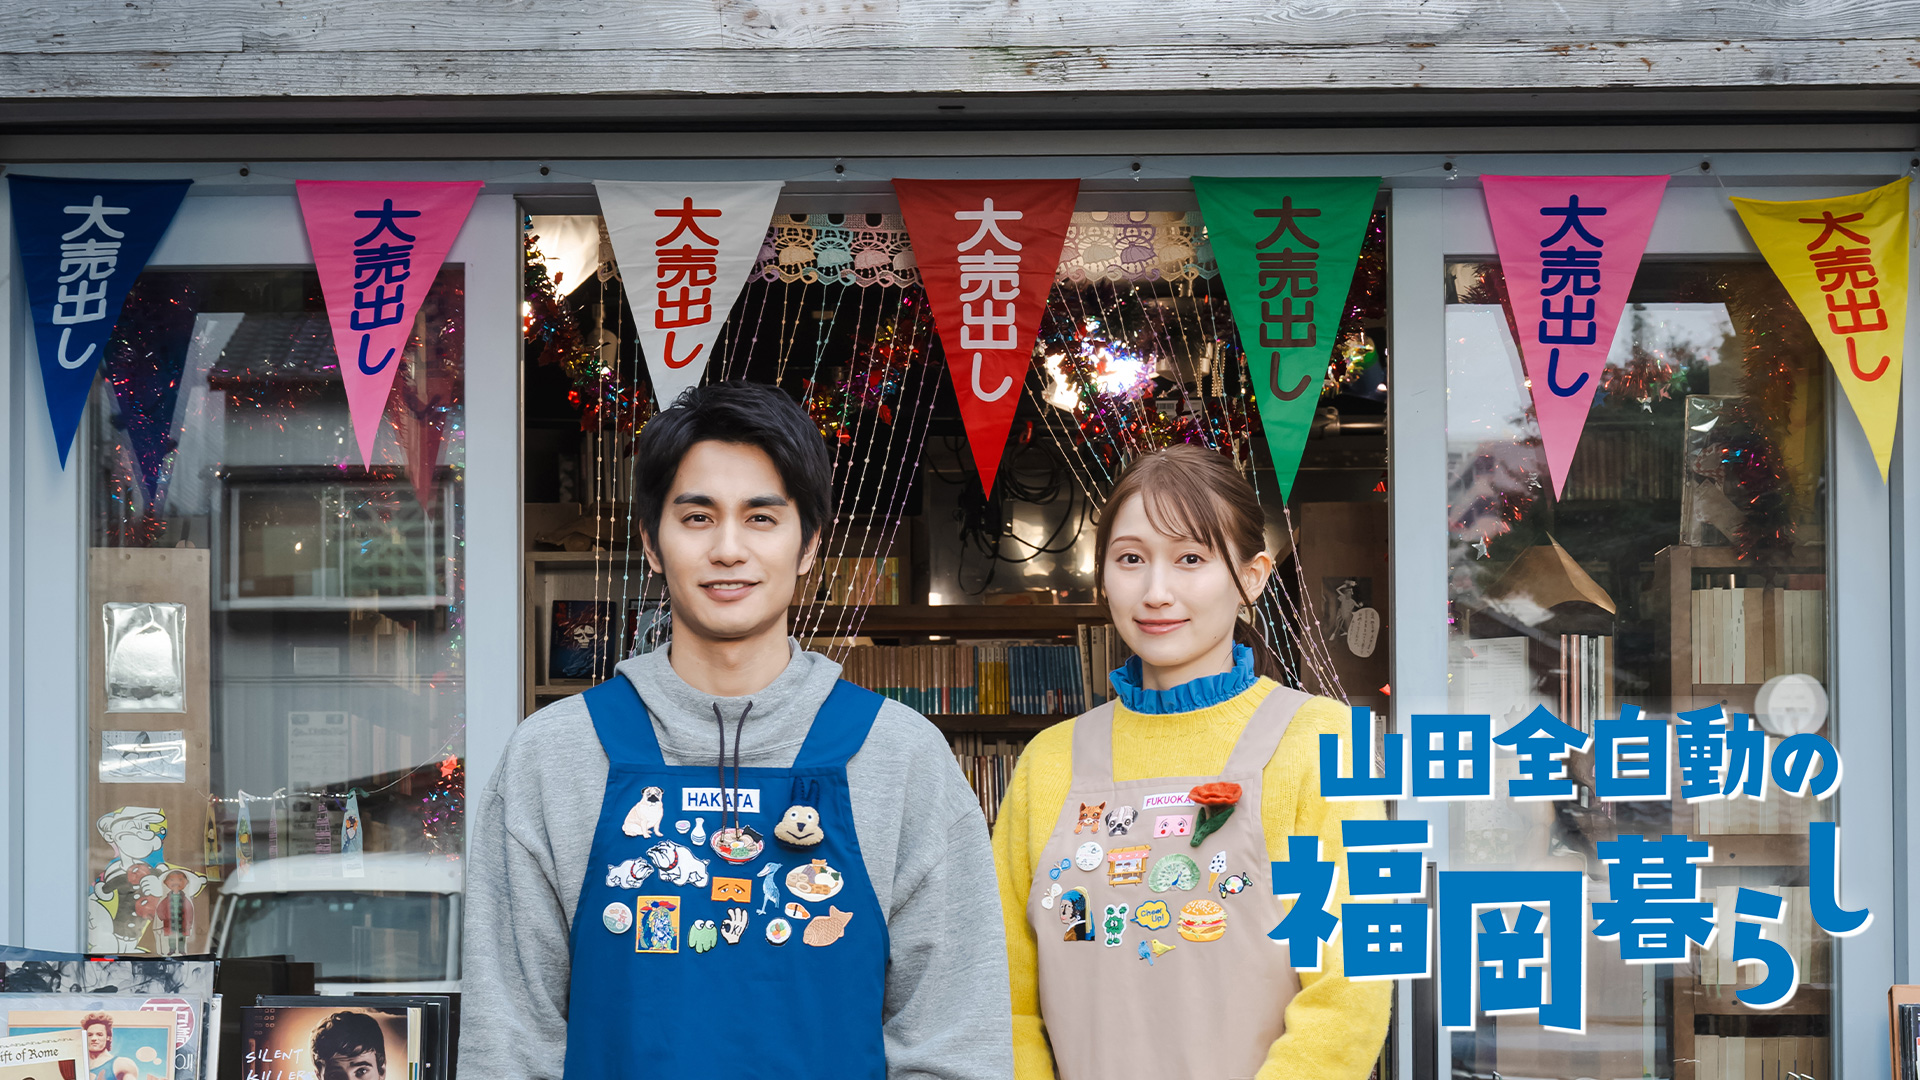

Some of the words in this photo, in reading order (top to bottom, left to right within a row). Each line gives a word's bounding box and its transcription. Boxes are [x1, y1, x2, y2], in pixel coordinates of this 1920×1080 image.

[52, 195, 131, 370] 大売出し
[350, 198, 422, 376] 大売出し
[655, 197, 722, 369] 大売出し
[954, 197, 1023, 402] 大売出し
[1253, 195, 1322, 402] 大売出し
[1539, 194, 1608, 398] 大売出し
[1798, 210, 1892, 383] 大売出し
[688, 792, 753, 808] HAKATA
[1146, 794, 1191, 807] FUKUOKA
[1152, 914, 1164, 923] Up!
[15, 1048, 26, 1062] of
[28, 1048, 59, 1060] Rome
[245, 1048, 303, 1064] SILENT
